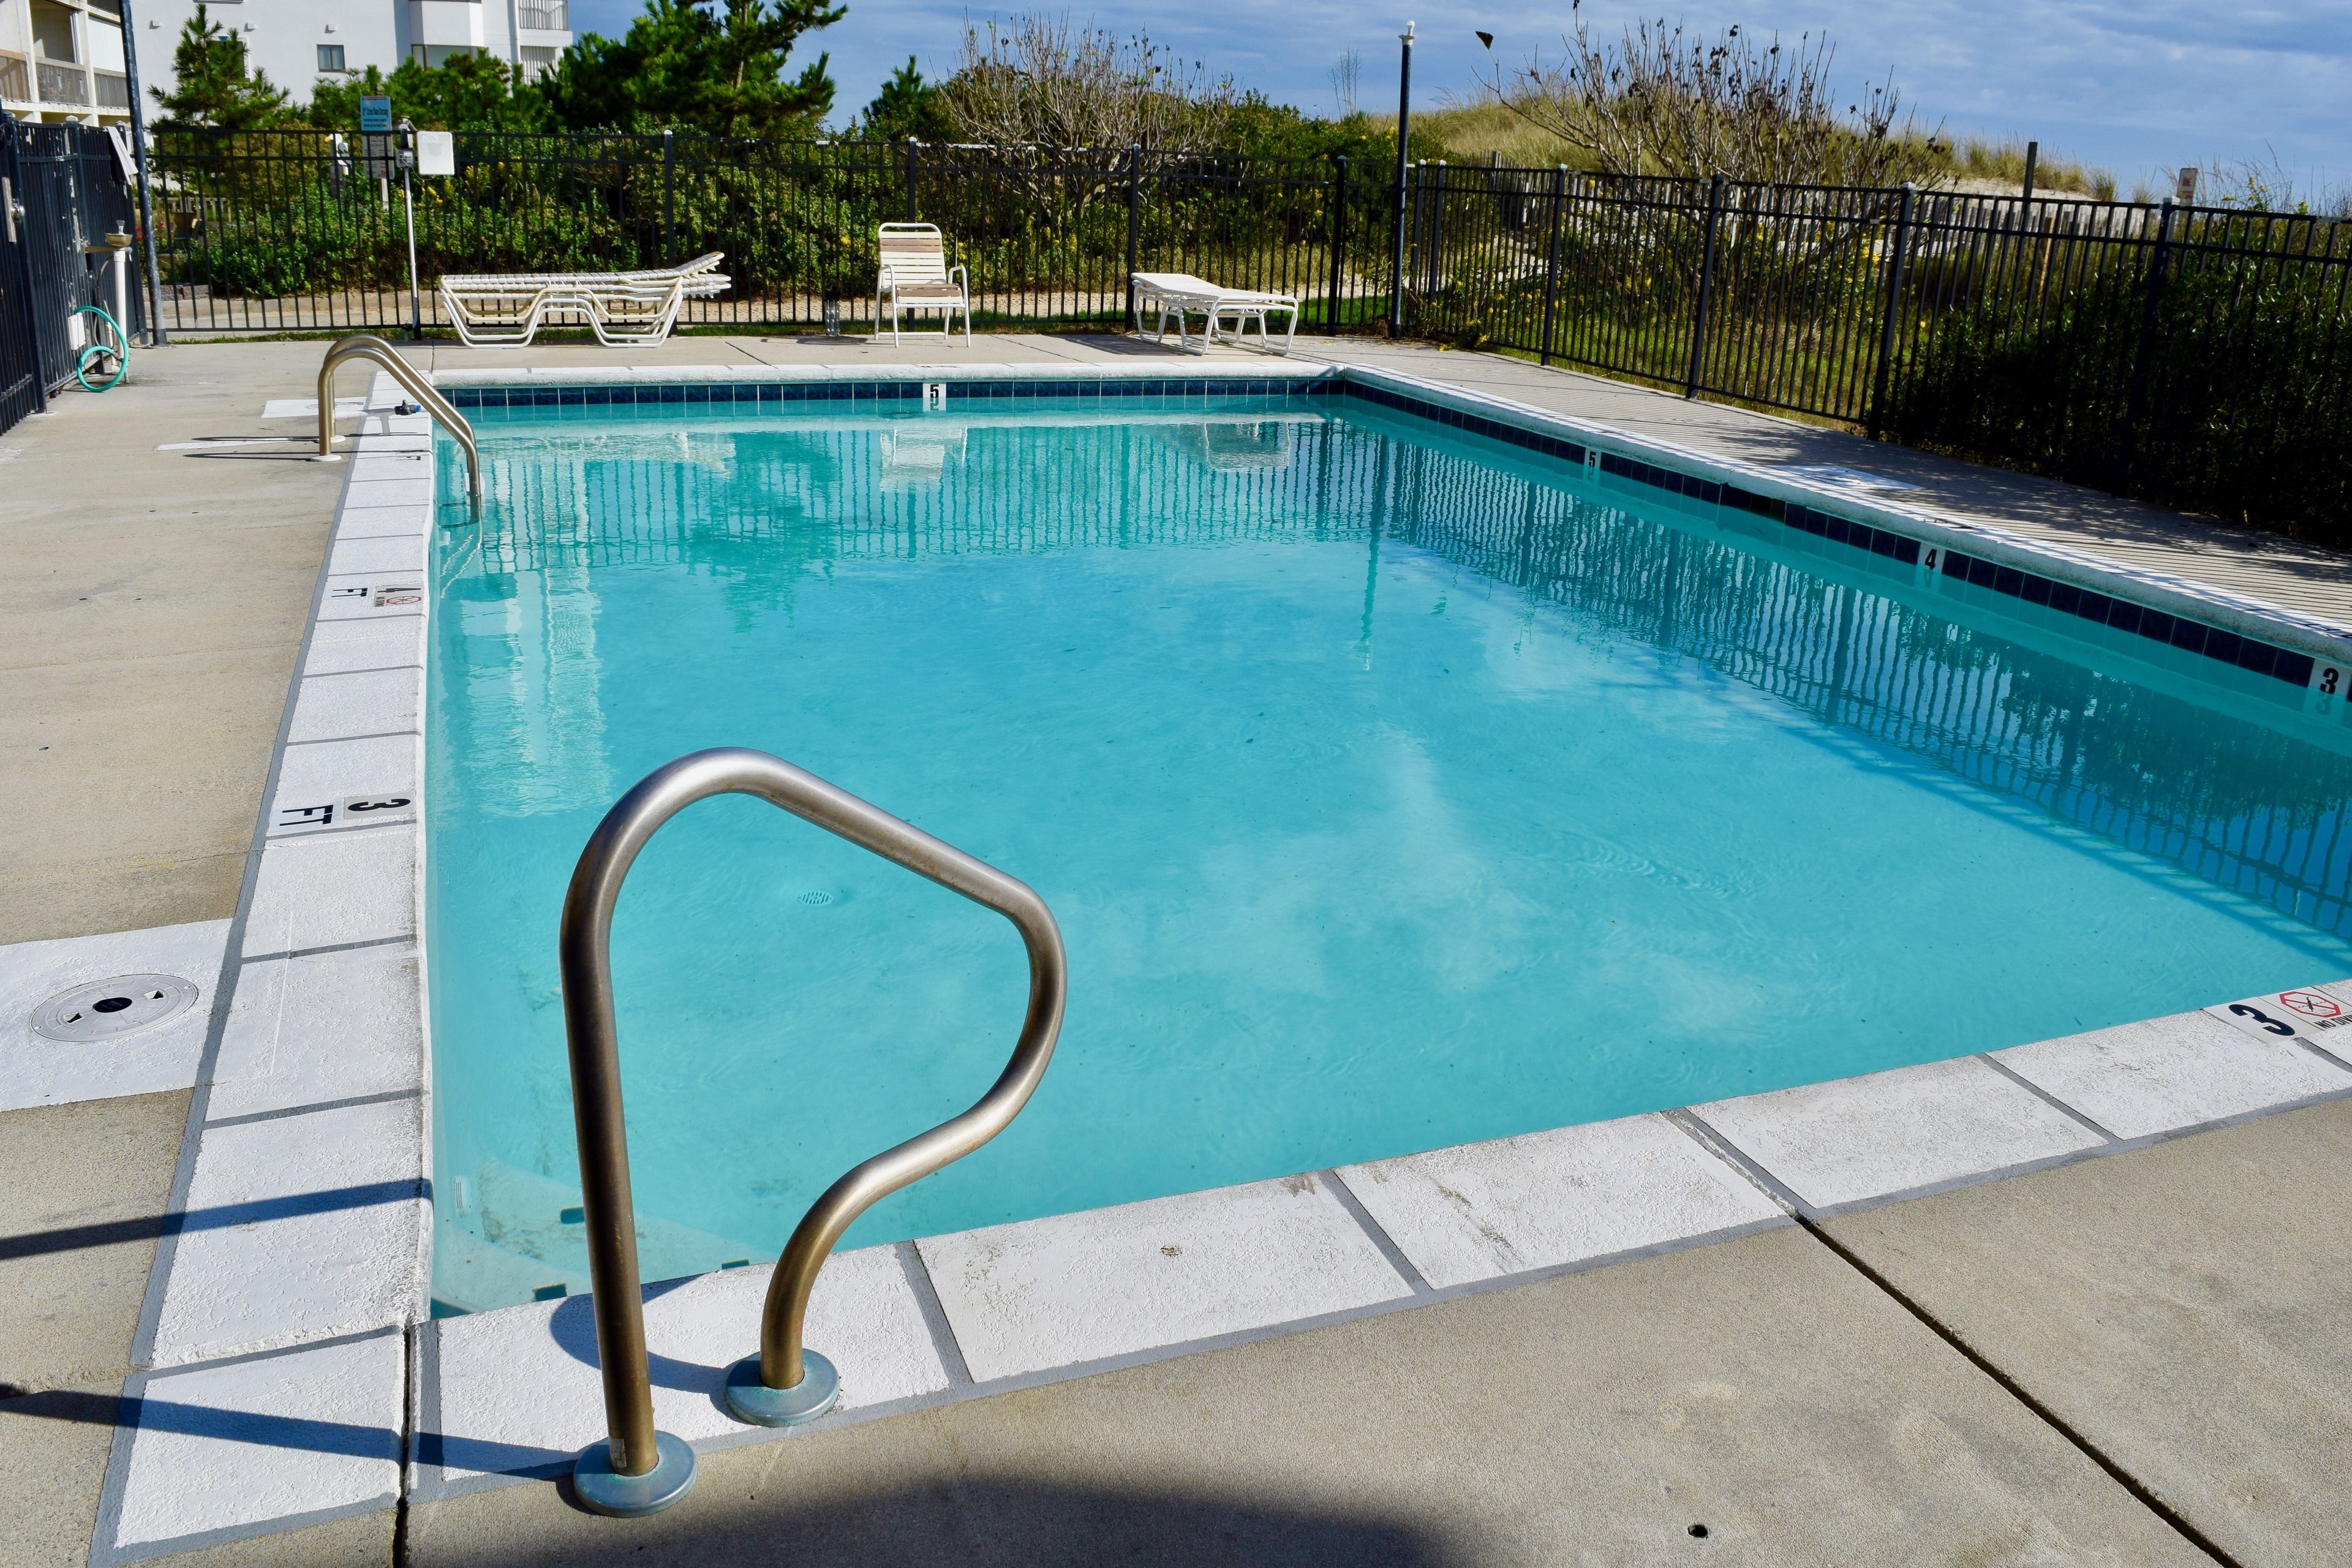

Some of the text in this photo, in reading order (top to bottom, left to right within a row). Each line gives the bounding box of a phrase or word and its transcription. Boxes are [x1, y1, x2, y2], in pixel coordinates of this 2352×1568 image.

[930, 383, 939, 398] 5
[1588, 451, 1596, 467] 5
[1925, 549, 1937, 569] 4
[331, 588, 368, 597] FT
[2320, 668, 2339, 695] 3
[347, 798, 411, 812] 3
[279, 805, 334, 826] FT
[2228, 1004, 2296, 1036] 3
[2330, 1014, 2352, 1025] DIVI
